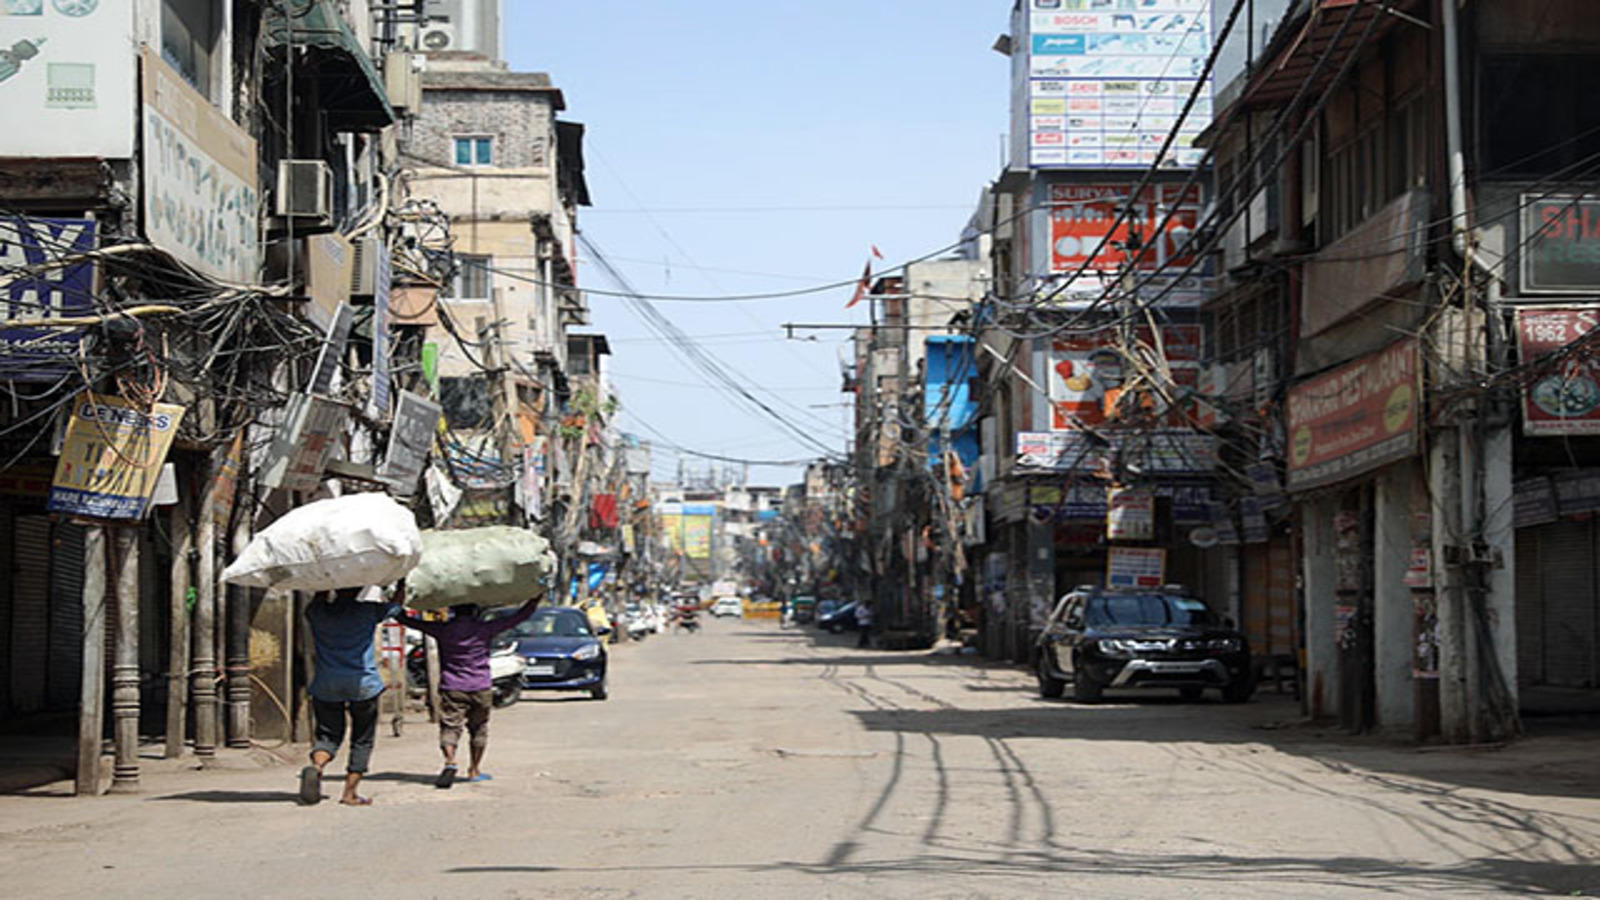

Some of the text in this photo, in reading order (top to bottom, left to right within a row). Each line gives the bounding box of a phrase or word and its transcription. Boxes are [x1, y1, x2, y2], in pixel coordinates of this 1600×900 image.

[1054, 16, 1098, 25] BOSCH
[1053, 186, 1113, 200] SURYA
[1525, 326, 1567, 343] 1962
